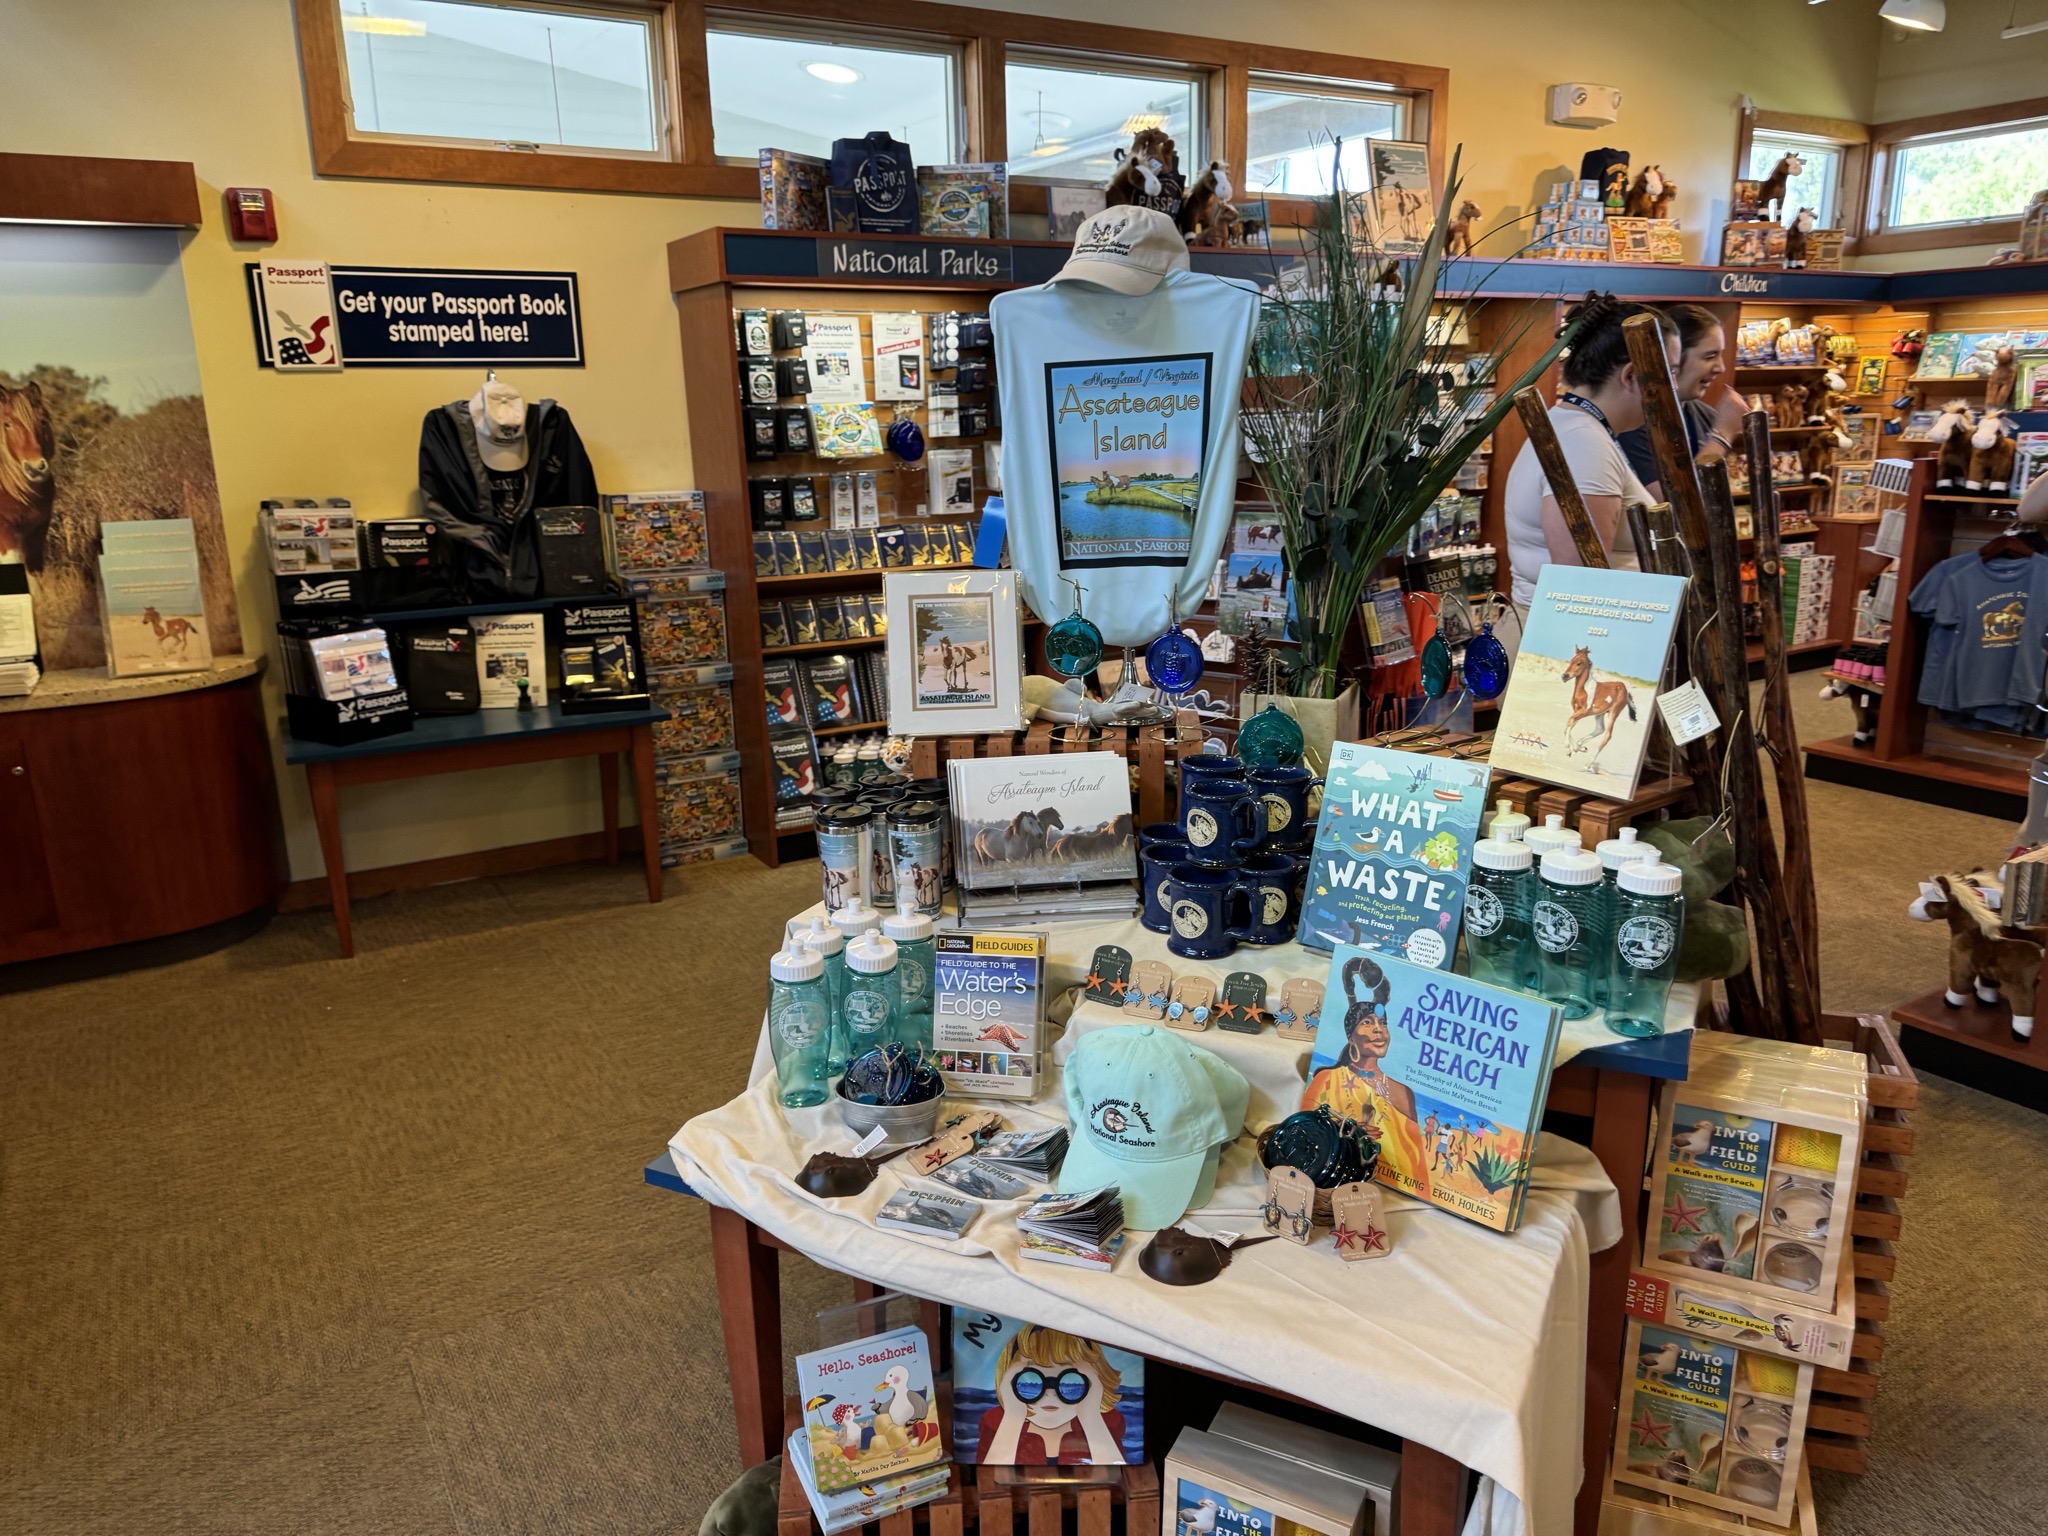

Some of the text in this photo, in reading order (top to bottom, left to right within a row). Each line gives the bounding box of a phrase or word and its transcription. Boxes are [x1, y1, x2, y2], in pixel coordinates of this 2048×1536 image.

[833, 244, 999, 277] National Parks
[267, 267, 324, 278] Passport
[1720, 273, 1768, 294] Children
[339, 290, 567, 319] Get your Passport Book
[389, 319, 529, 347] stamped here!
[1083, 369, 1143, 389] Maryland
[1154, 368, 1200, 386] Virginia
[1058, 384, 1200, 424] Assateague
[1093, 419, 1167, 460] Island
[381, 537, 428, 547] Passport
[1070, 542, 1132, 557] NATIONAL
[706, 575, 725, 583] 1000
[1427, 567, 1459, 584] DEADLY
[1430, 578, 1461, 593] STORMS
[583, 607, 631, 618] Passport
[1552, 593, 1571, 601] FIELD
[1571, 595, 1593, 604] GUIDE
[1594, 597, 1605, 605] TO
[1605, 598, 1619, 606] THE
[1620, 599, 1638, 609] WILD
[1639, 601, 1670, 613] HORSES
[1555, 604, 1654, 623] OF ASSATEAGUE ISLAND
[491, 622, 535, 630] Passport
[566, 627, 607, 635] Cancellation
[1587, 627, 1608, 636] 2024
[764, 670, 789, 679] ssport
[811, 668, 844, 677] Passport
[357, 691, 408, 710] Passport
[772, 742, 808, 753] Passport
[1342, 750, 1352, 759] DK
[987, 775, 1105, 803] Assateague Island
[1351, 789, 1447, 832] WHAT
[1383, 829, 1404, 854] A
[1327, 860, 1446, 911] WASTE
[1348, 902, 1384, 920] protecting
[1396, 913, 1420, 923] planet
[1355, 915, 1395, 931] Jess French
[975, 941, 999, 950] FIELD
[1000, 943, 1034, 952] GUIDES
[941, 959, 963, 967] FIELD
[964, 960, 987, 968] GUIDE
[1001, 962, 1017, 970] THE
[939, 969, 1027, 995] Water's
[939, 992, 1002, 1020] Edge
[1417, 982, 1518, 1032] SAVING
[1397, 1007, 1530, 1069] AMERICAN
[1417, 1041, 1502, 1090] BEACH
[1405, 1065, 1417, 1074] The
[1417, 1069, 1446, 1085] Biography
[1453, 1082, 1474, 1095] African
[1475, 1090, 1503, 1105] American
[1405, 1075, 1451, 1096] Environmentalist
[1090, 1098, 1156, 1135] Assateague Island
[1090, 1124, 1156, 1148] National Seashore
[1713, 1125, 1760, 1142] INTO
[1710, 1146, 1758, 1163] FIELD
[1739, 1142, 1760, 1153] THE
[968, 1158, 1017, 1183] DOLPHIN
[1721, 1160, 1757, 1174] GUIDE
[1375, 1163, 1425, 1192] YLINE KING
[1683, 1169, 1702, 1177] Walk
[1730, 1177, 1755, 1188] Beach
[908, 1190, 966, 1207] DOLPHIN
[1431, 1188, 1495, 1220] EKUA HOLMES
[1625, 1278, 1638, 1308] INTO
[1637, 1290, 1645, 1302] THE
[1644, 1283, 1656, 1314] FIELD
[1656, 1290, 1665, 1312] GUIDE
[1697, 1308, 1717, 1319] Walk
[1730, 1316, 1744, 1325] the
[1745, 1320, 1770, 1333] Beach
[962, 1313, 1003, 1349] My
[817, 1341, 918, 1377] Hello, Seashore!
[1679, 1348, 1723, 1367] INTO
[1676, 1367, 1721, 1386] FIELD
[1703, 1365, 1723, 1376] THE
[1650, 1385, 1669, 1397] Walk
[1681, 1392, 1693, 1402] the
[1695, 1396, 1719, 1409] Beach
[1687, 1382, 1720, 1396] GUIDE
[861, 1466, 879, 1474] Martha
[1218, 1505, 1262, 1529] INTO
